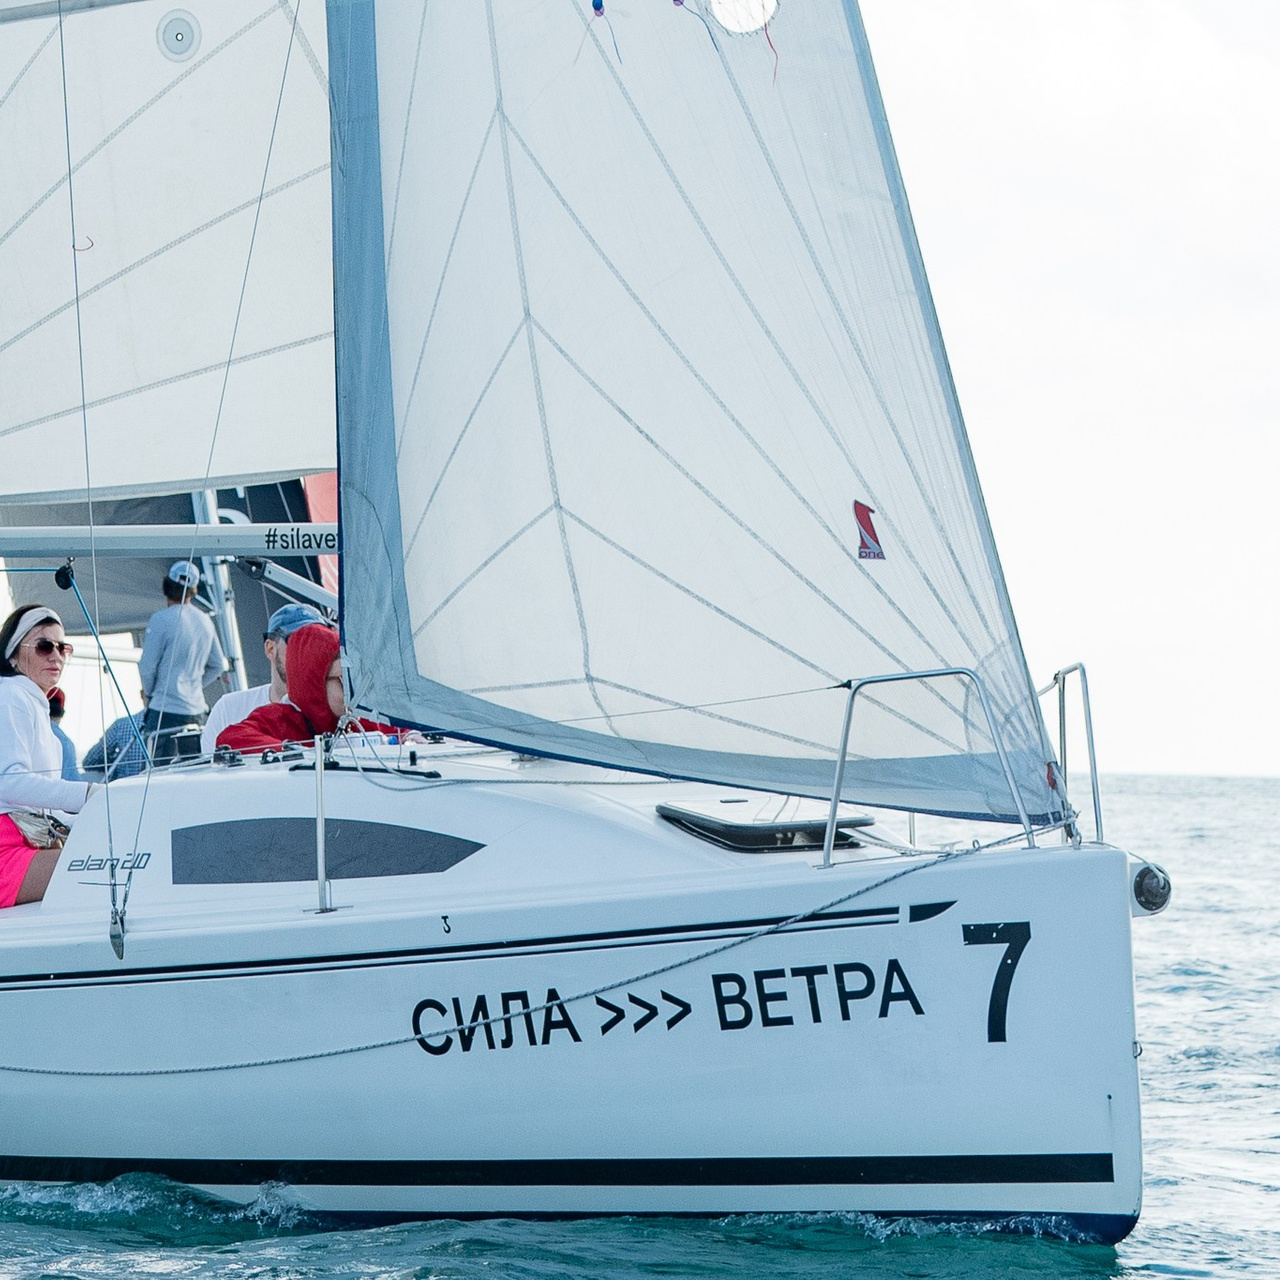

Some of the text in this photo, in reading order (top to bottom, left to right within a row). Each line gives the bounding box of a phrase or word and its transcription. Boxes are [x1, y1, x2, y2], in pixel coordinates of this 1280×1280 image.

[265, 527, 339, 549] #silave
[412, 958, 925, 1056] СИЛА ВЕТРА
[961, 921, 1032, 1043] 7
